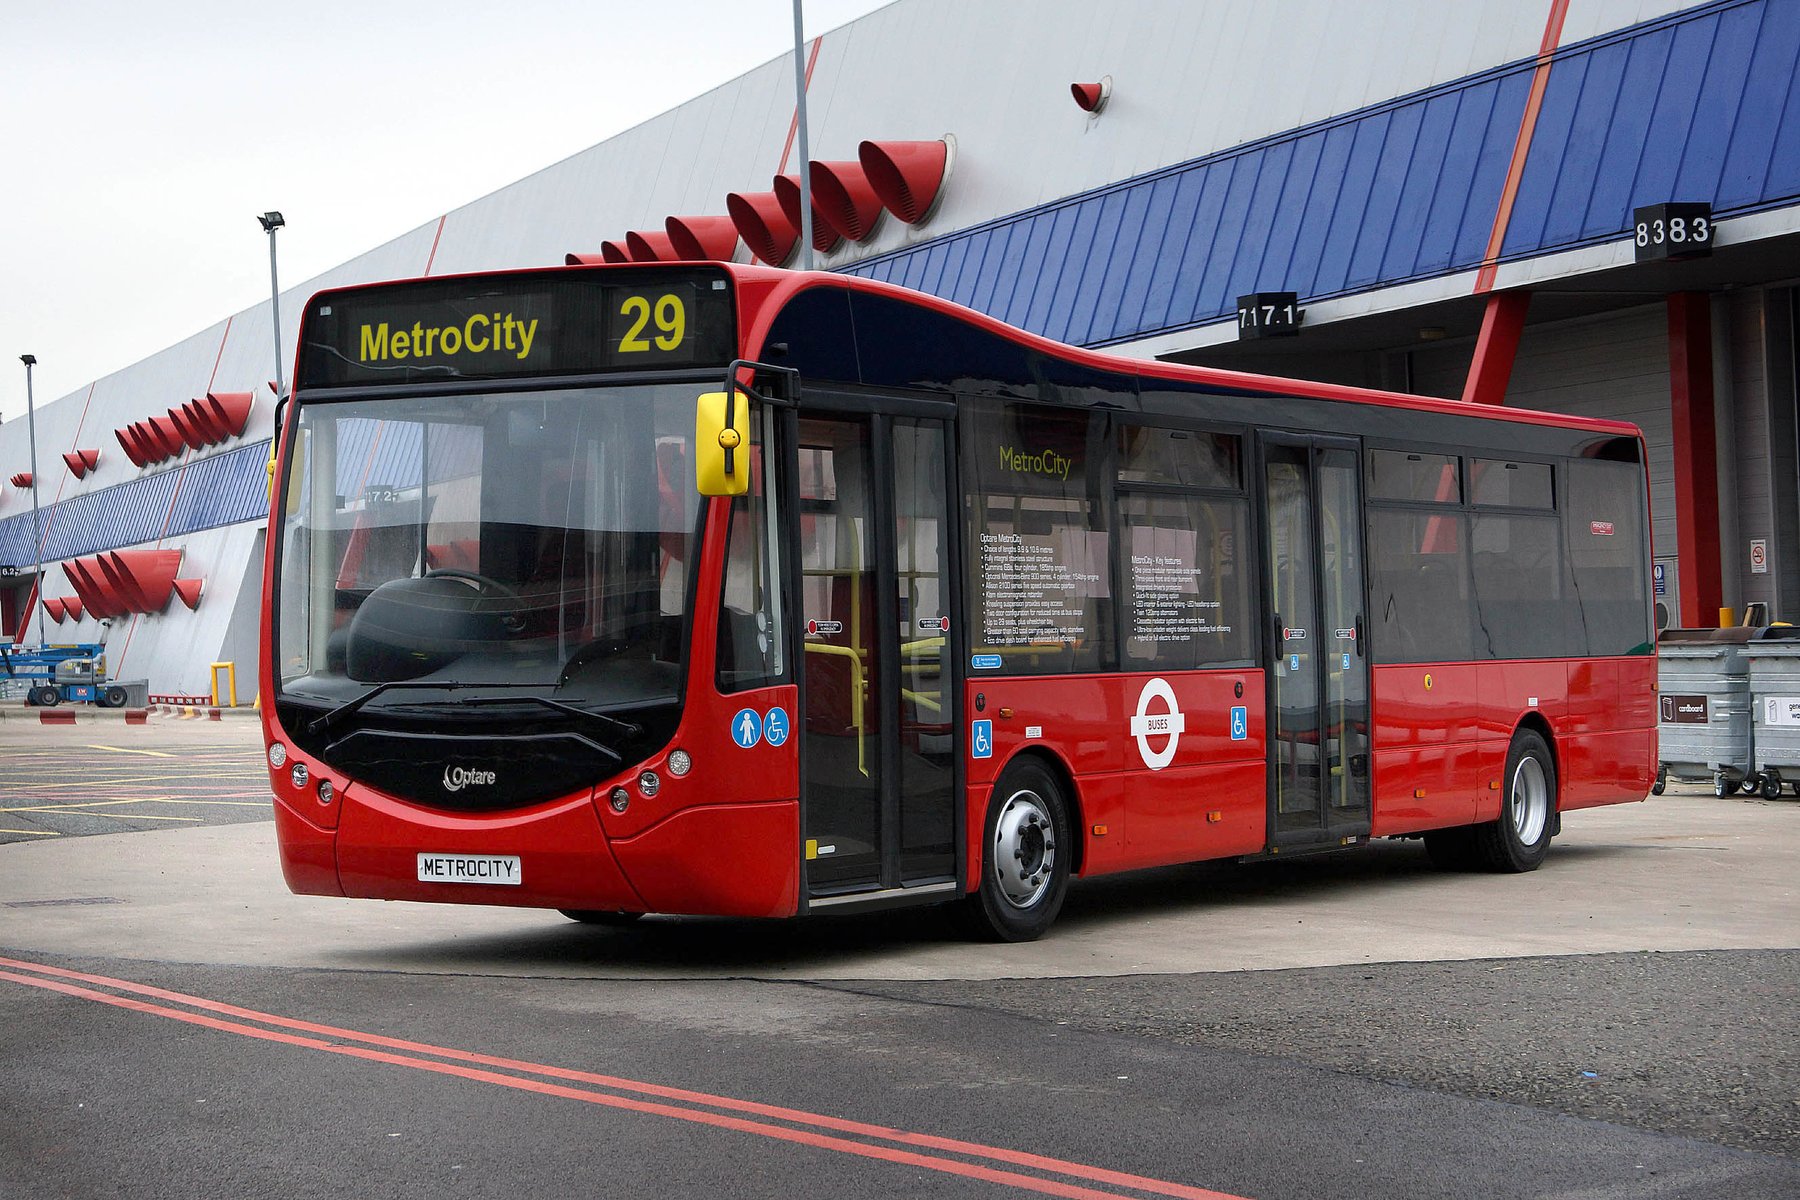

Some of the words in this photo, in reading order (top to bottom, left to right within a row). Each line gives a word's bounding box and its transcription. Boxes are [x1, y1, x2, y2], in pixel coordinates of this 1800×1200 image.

[1636, 222, 1664, 247] 8.3
[1670, 218, 1708, 242] 8.3
[618, 294, 685, 352] 29
[1239, 306, 1257, 328] 7.1
[1262, 305, 1293, 325] 7.1
[360, 312, 538, 361] MetroCity
[1000, 446, 1071, 482] MetroCity
[980, 534, 998, 544] Optare
[998, 534, 1022, 545] MetroCity
[1678, 704, 1704, 712] cardboard
[1148, 719, 1168, 730] BUSES
[452, 766, 496, 788] Optare
[424, 858, 514, 877] METROCITY
